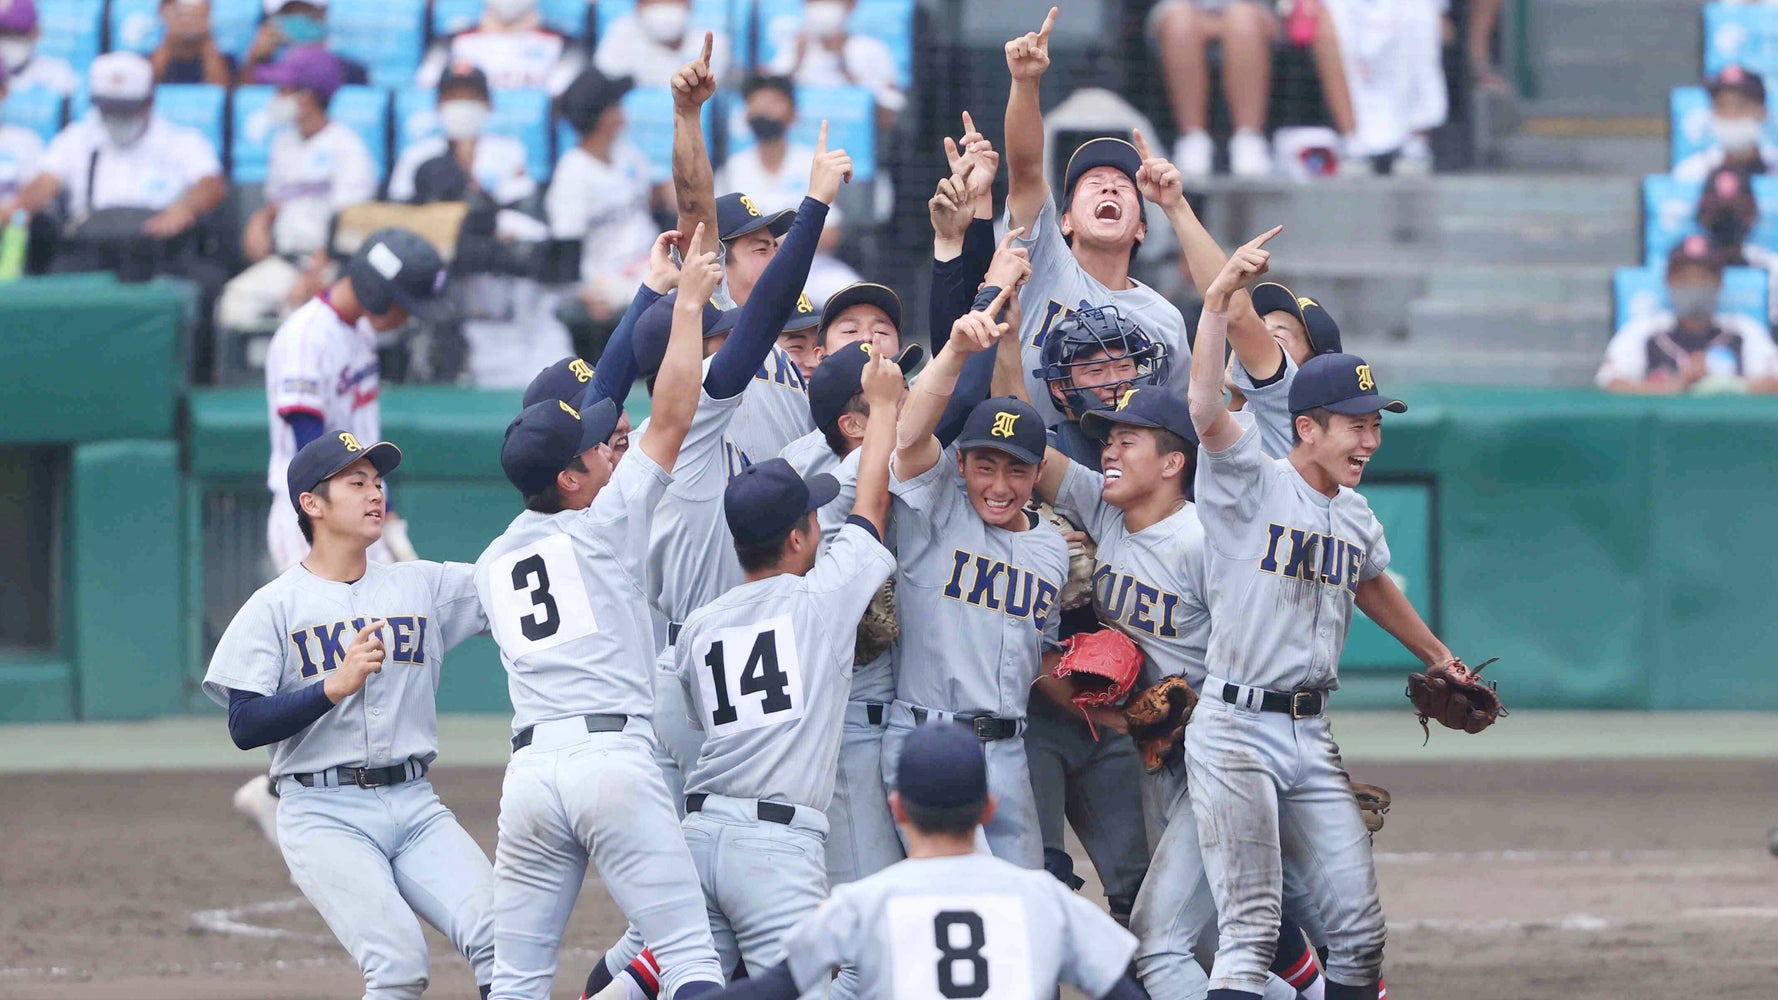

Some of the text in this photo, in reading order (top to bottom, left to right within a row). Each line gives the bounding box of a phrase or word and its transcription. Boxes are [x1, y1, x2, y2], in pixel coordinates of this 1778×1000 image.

[511, 553, 560, 642] 3
[1259, 522, 1366, 597] IKUE
[704, 629, 792, 726] 14
[933, 910, 989, 999] 8
